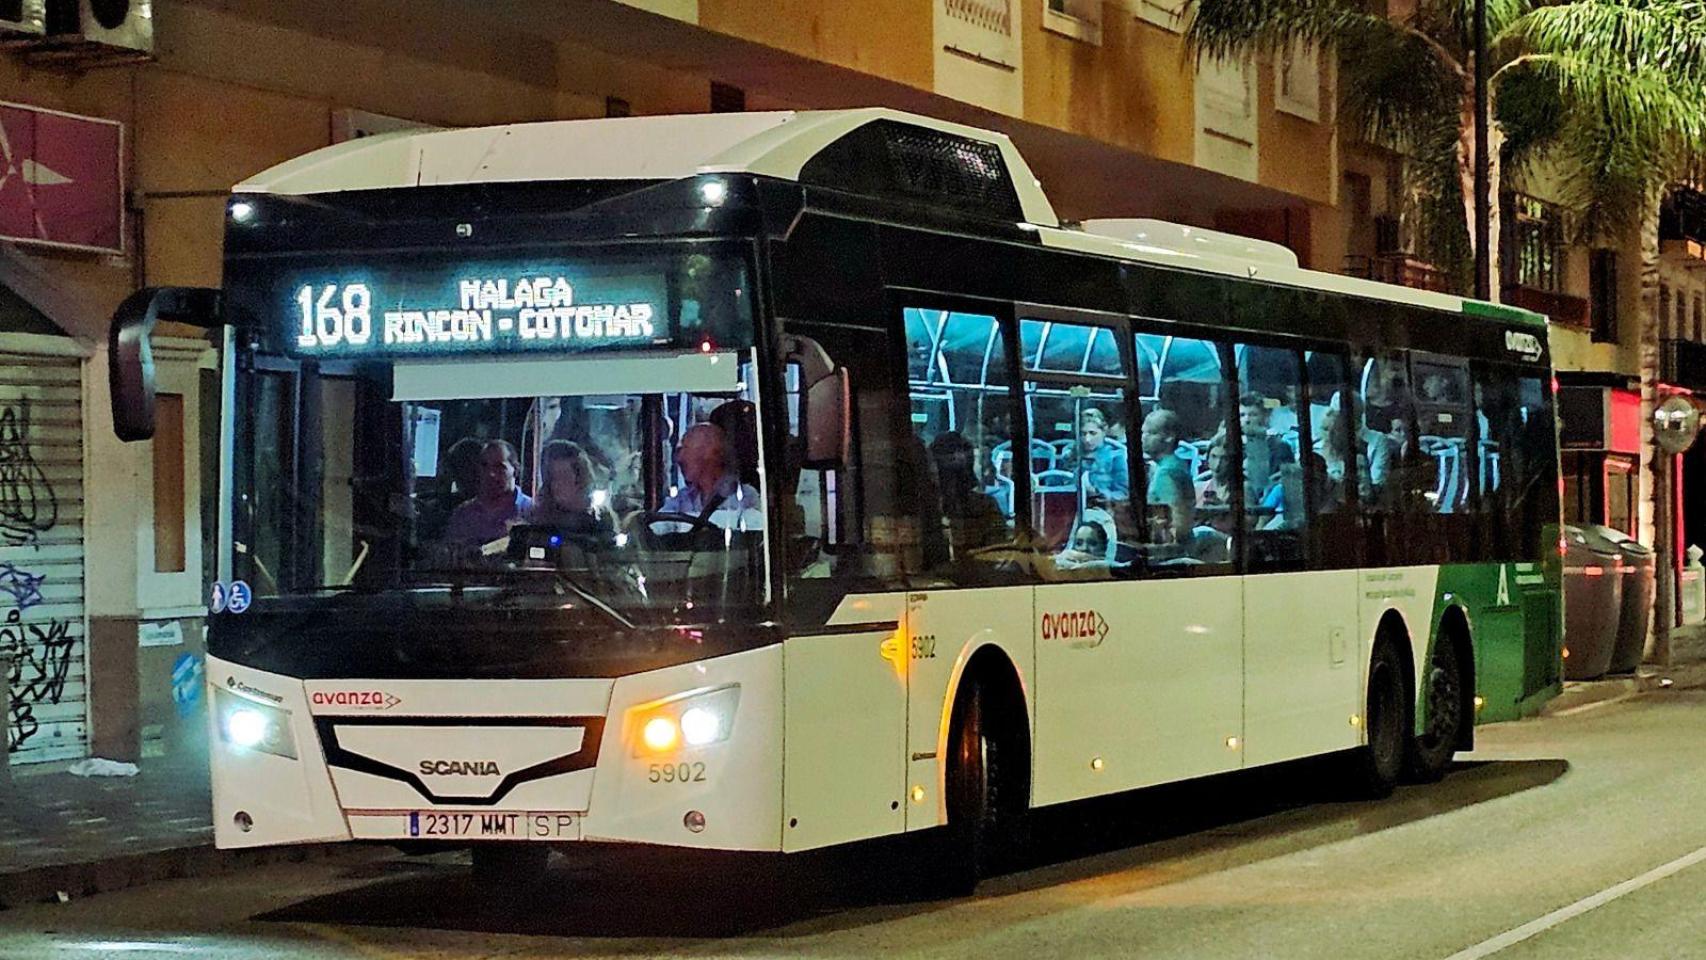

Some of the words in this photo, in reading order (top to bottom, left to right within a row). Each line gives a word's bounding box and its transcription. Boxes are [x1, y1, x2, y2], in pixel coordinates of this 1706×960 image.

[460, 277, 573, 310] MALAGA
[297, 283, 372, 347] 168
[383, 309, 492, 344] RINCON
[519, 303, 655, 339] COTOMAR
[1042, 610, 1096, 640] avanza
[911, 634, 936, 659] 5902
[312, 691, 383, 705] avanza
[419, 760, 500, 776] SCANIA
[648, 762, 707, 783] 5902
[425, 814, 474, 835] 2317
[480, 814, 519, 835] MMT
